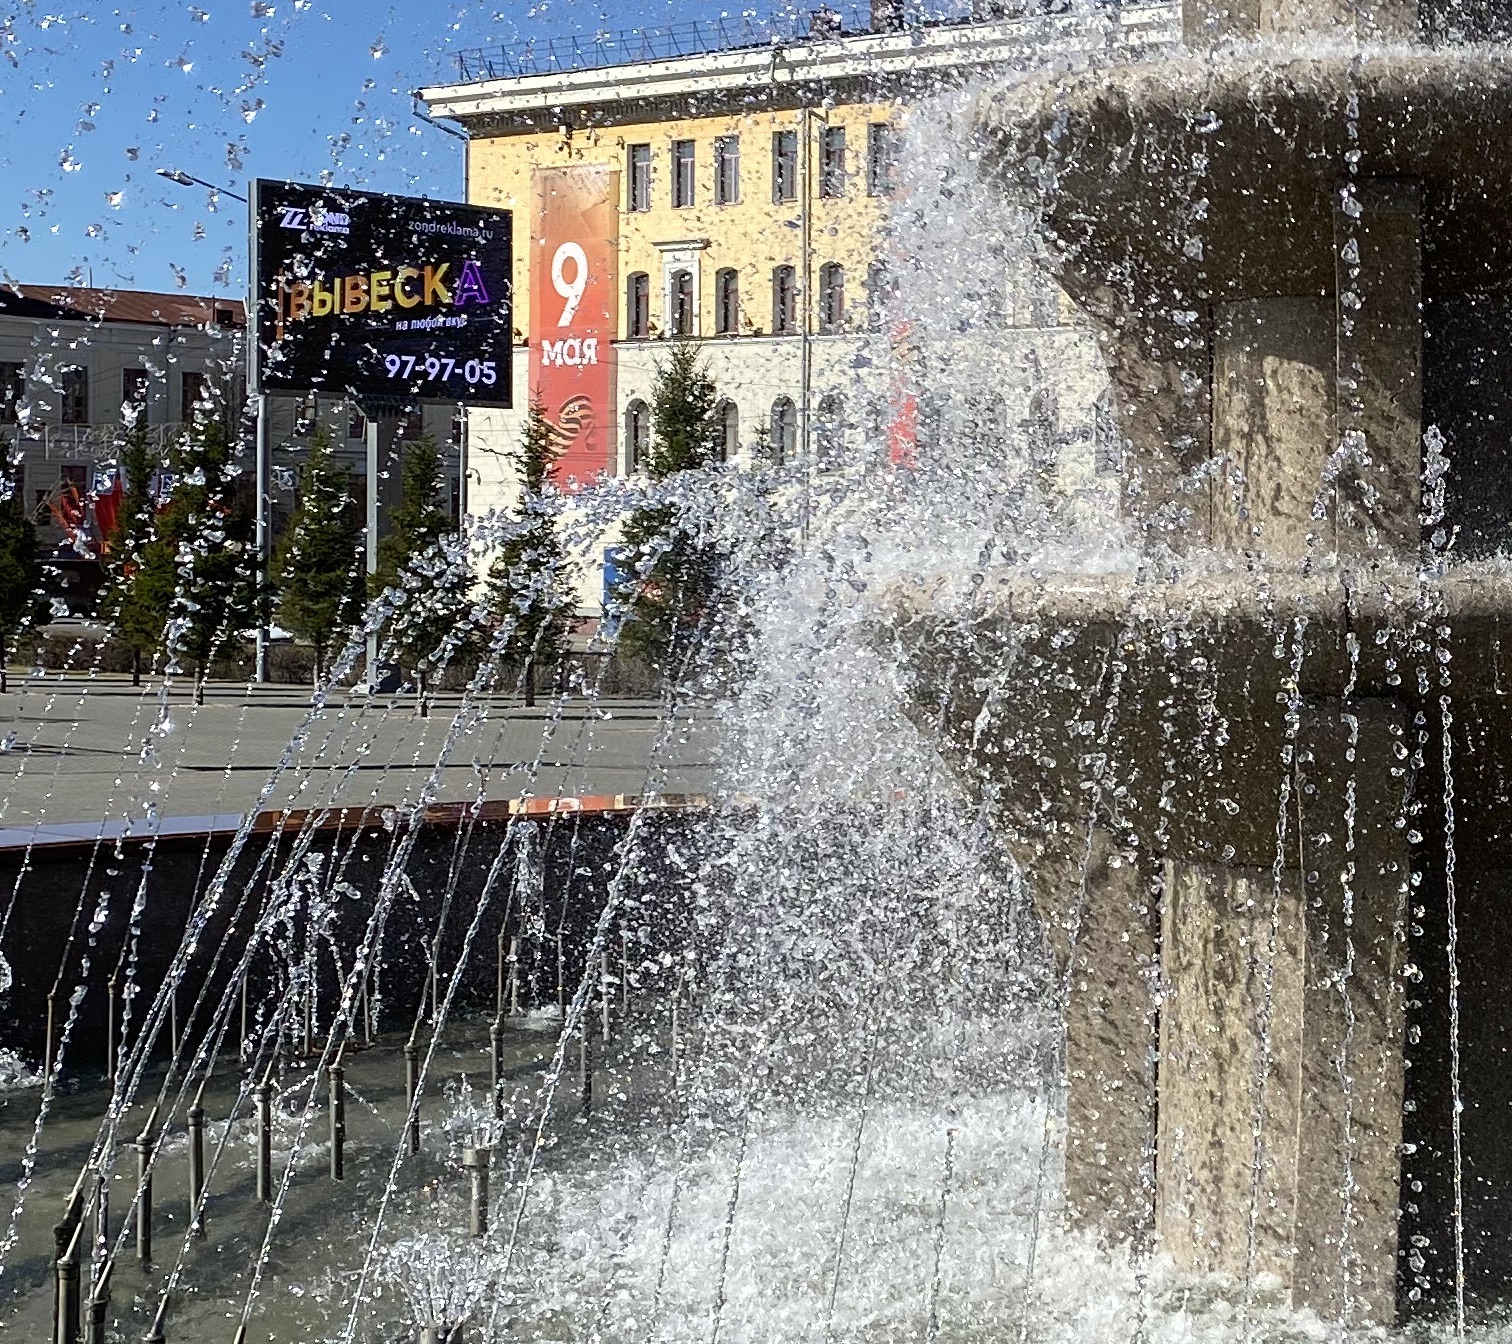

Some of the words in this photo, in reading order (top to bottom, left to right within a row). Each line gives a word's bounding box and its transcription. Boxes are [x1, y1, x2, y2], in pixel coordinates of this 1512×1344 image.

[408, 219, 493, 240] zondreklama.ru
[290, 260, 491, 320] ВЫВЕСКА
[551, 242, 588, 327] 9
[395, 320, 408, 331] на
[384, 354, 497, 385] 97-97-05
